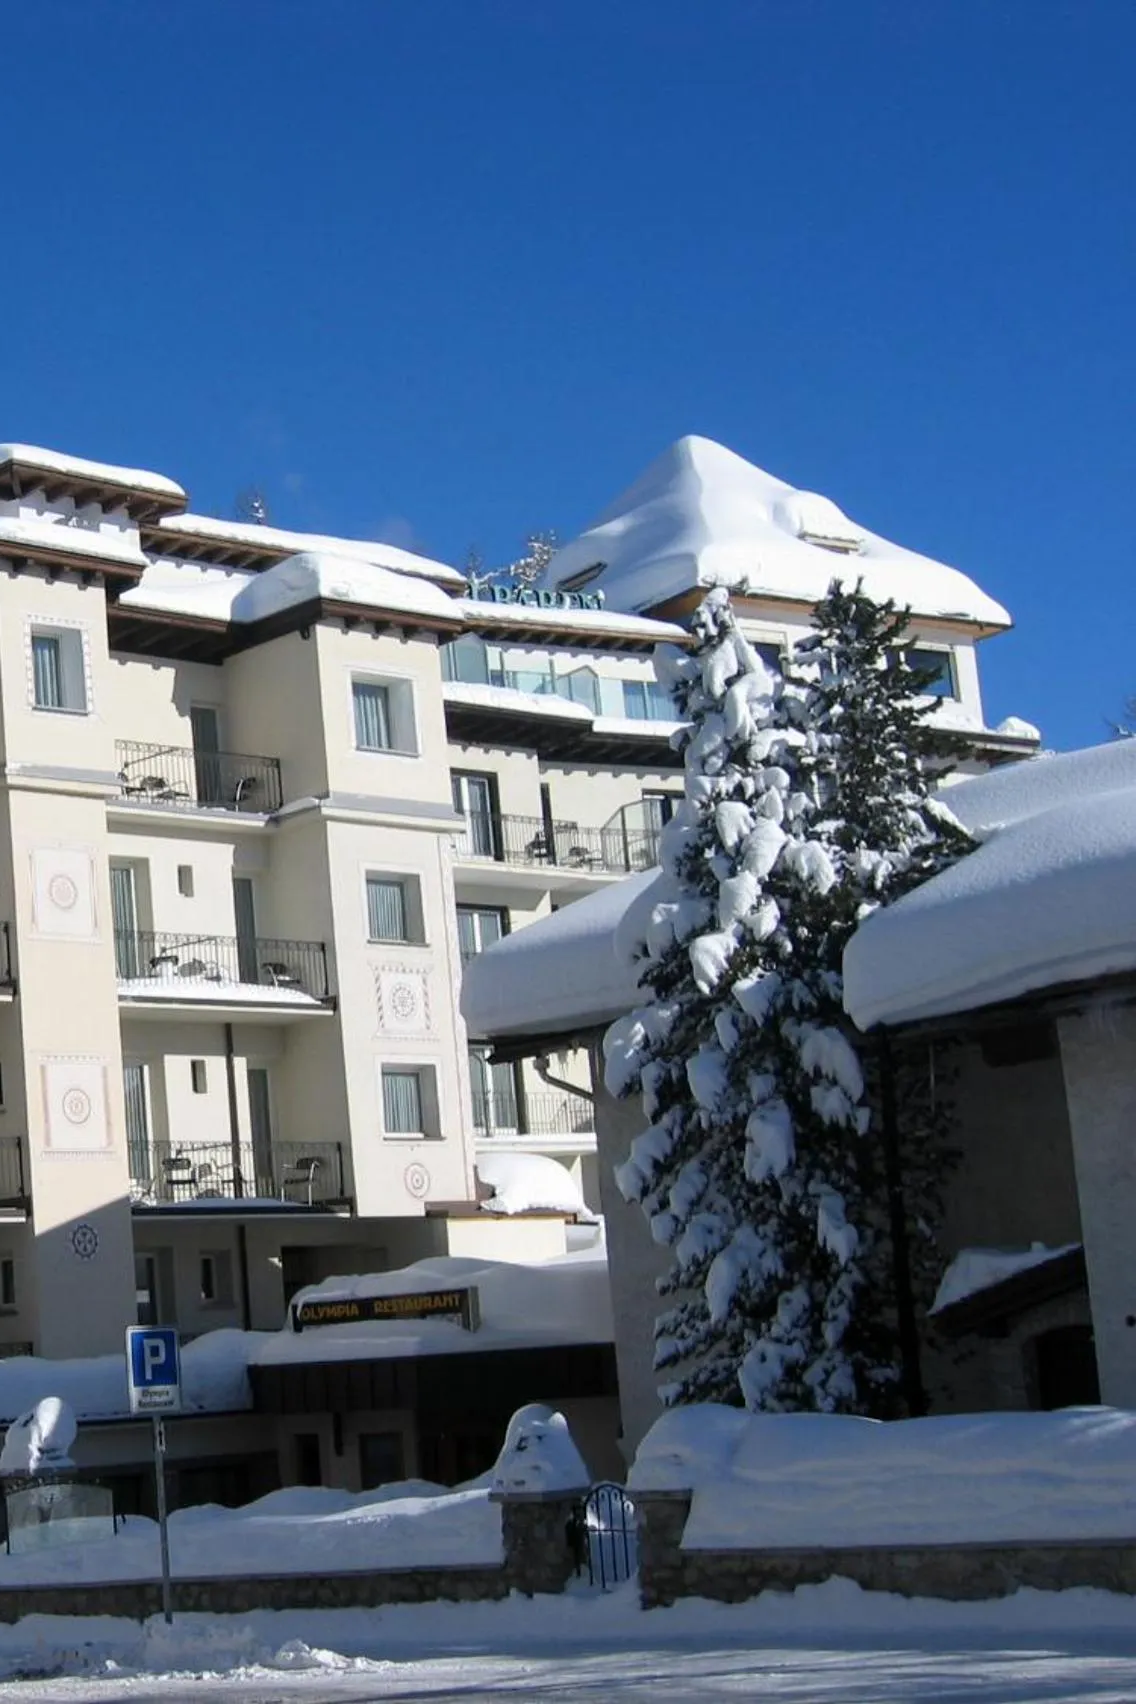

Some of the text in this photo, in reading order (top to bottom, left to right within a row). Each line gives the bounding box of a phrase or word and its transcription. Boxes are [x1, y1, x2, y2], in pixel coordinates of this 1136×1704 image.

[300, 1293, 461, 1321] OLYMPIA RESTAURANT
[143, 1338, 166, 1381] P
